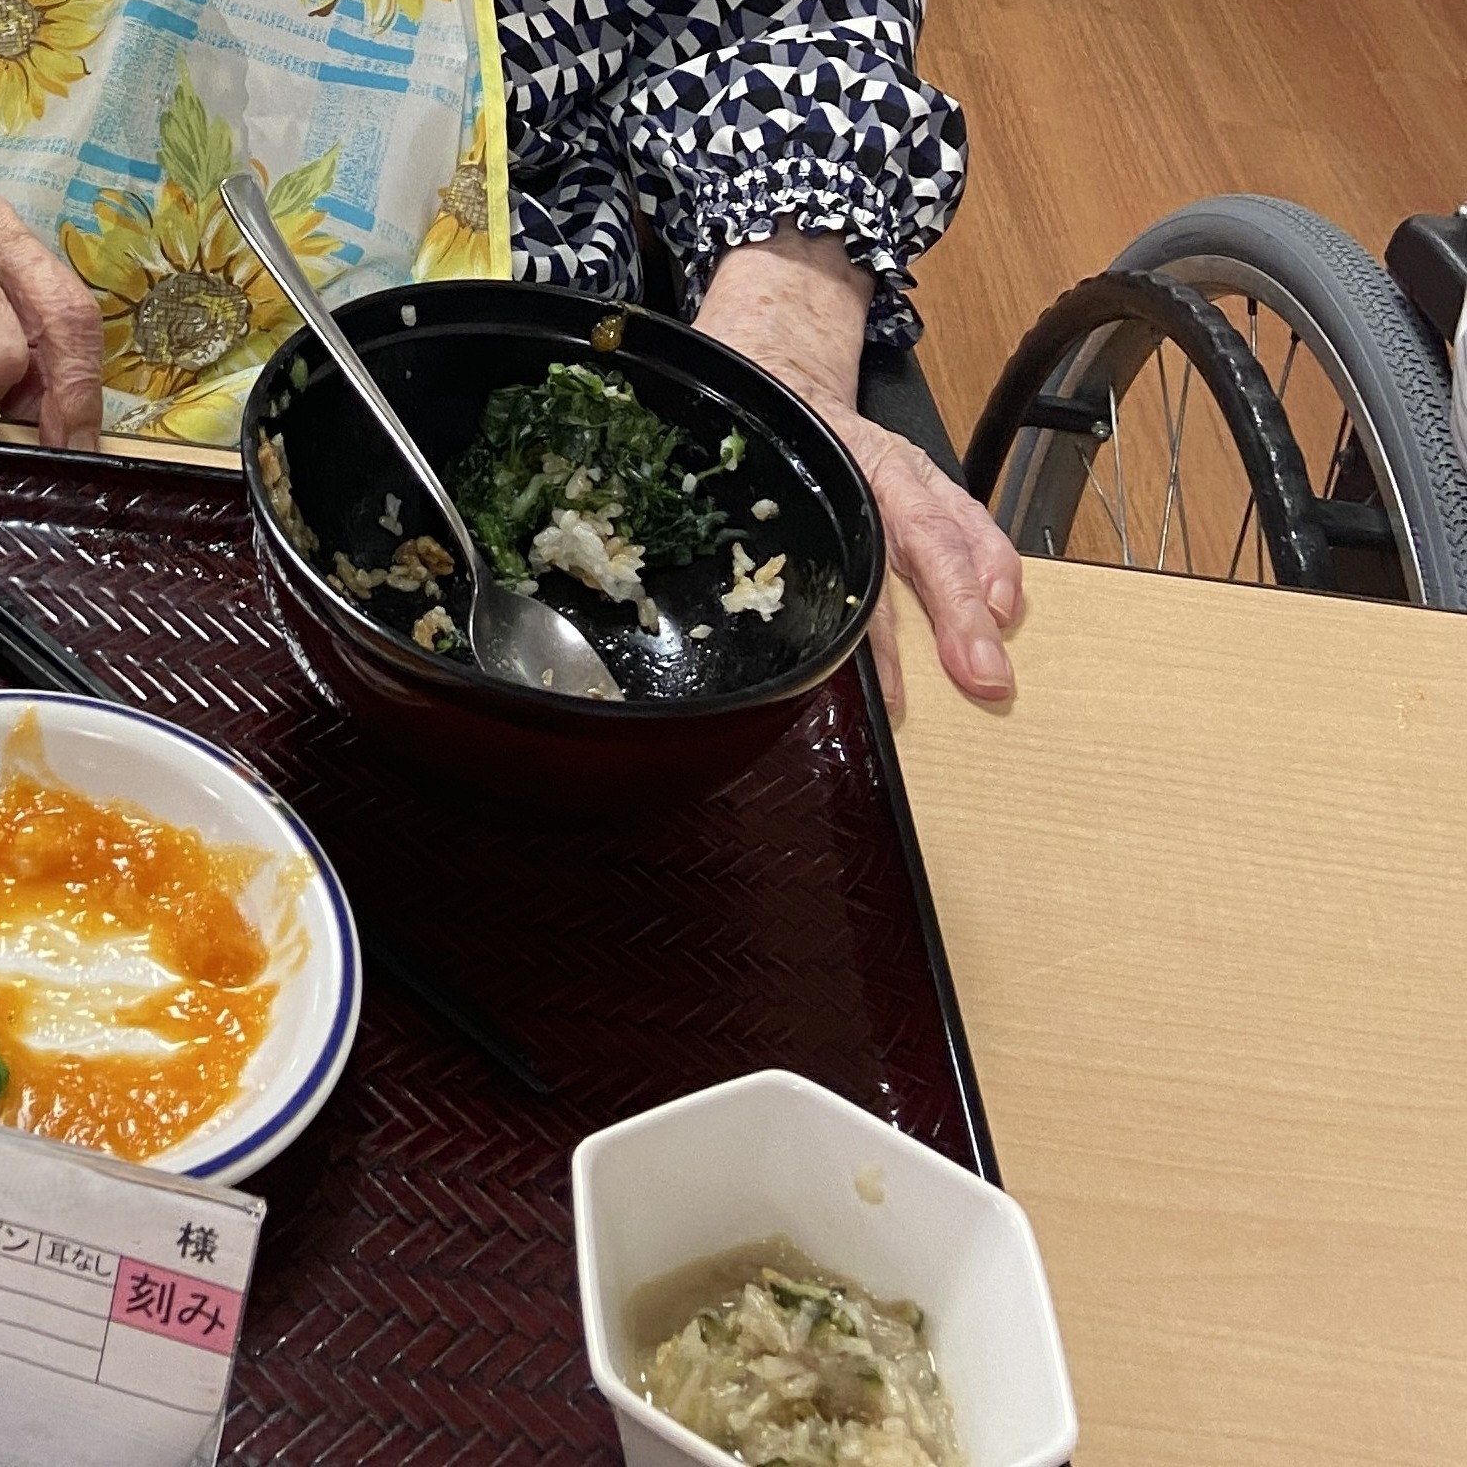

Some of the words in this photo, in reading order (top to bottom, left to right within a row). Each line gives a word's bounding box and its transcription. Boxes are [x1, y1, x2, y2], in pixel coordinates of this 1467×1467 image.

[46, 1239, 111, 1277] 耳なし
[176, 1221, 219, 1264] 様
[126, 1273, 225, 1335] 刻み
